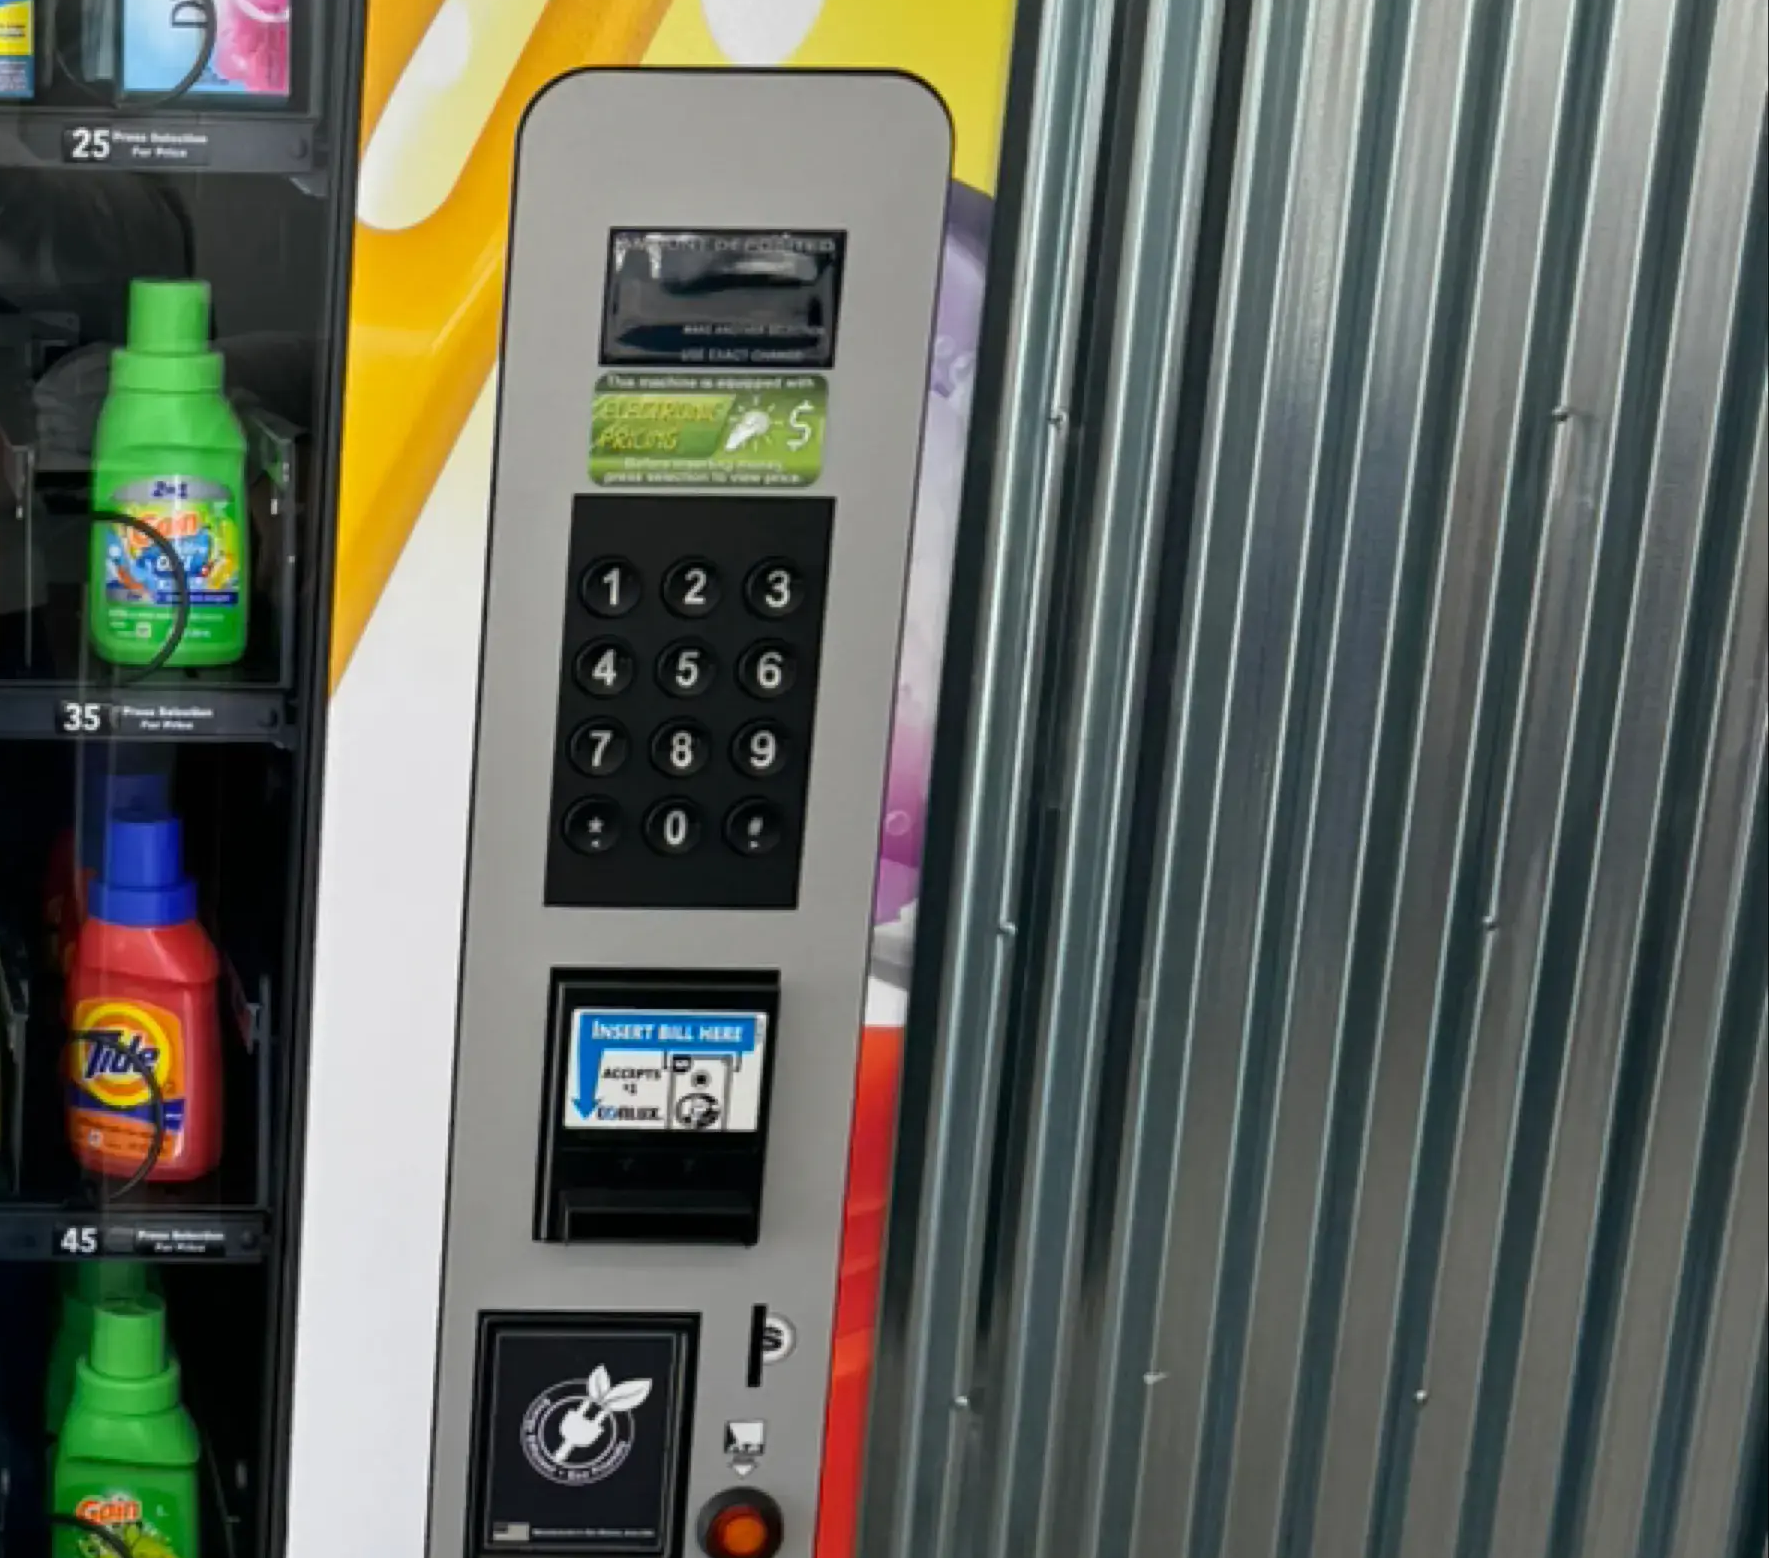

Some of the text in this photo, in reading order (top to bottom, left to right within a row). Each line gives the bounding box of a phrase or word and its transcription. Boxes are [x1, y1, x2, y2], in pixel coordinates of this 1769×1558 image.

[72, 127, 110, 159] 25
[602, 567, 793, 609] 1 2 3
[592, 648, 784, 689] 4 5 6
[64, 702, 101, 731] 35
[588, 729, 777, 769] 7 8 9
[664, 810, 688, 845] 0
[657, 1023, 695, 1041] BILL
[60, 1227, 98, 1253] 45
[75, 1496, 143, 1526] Gain
